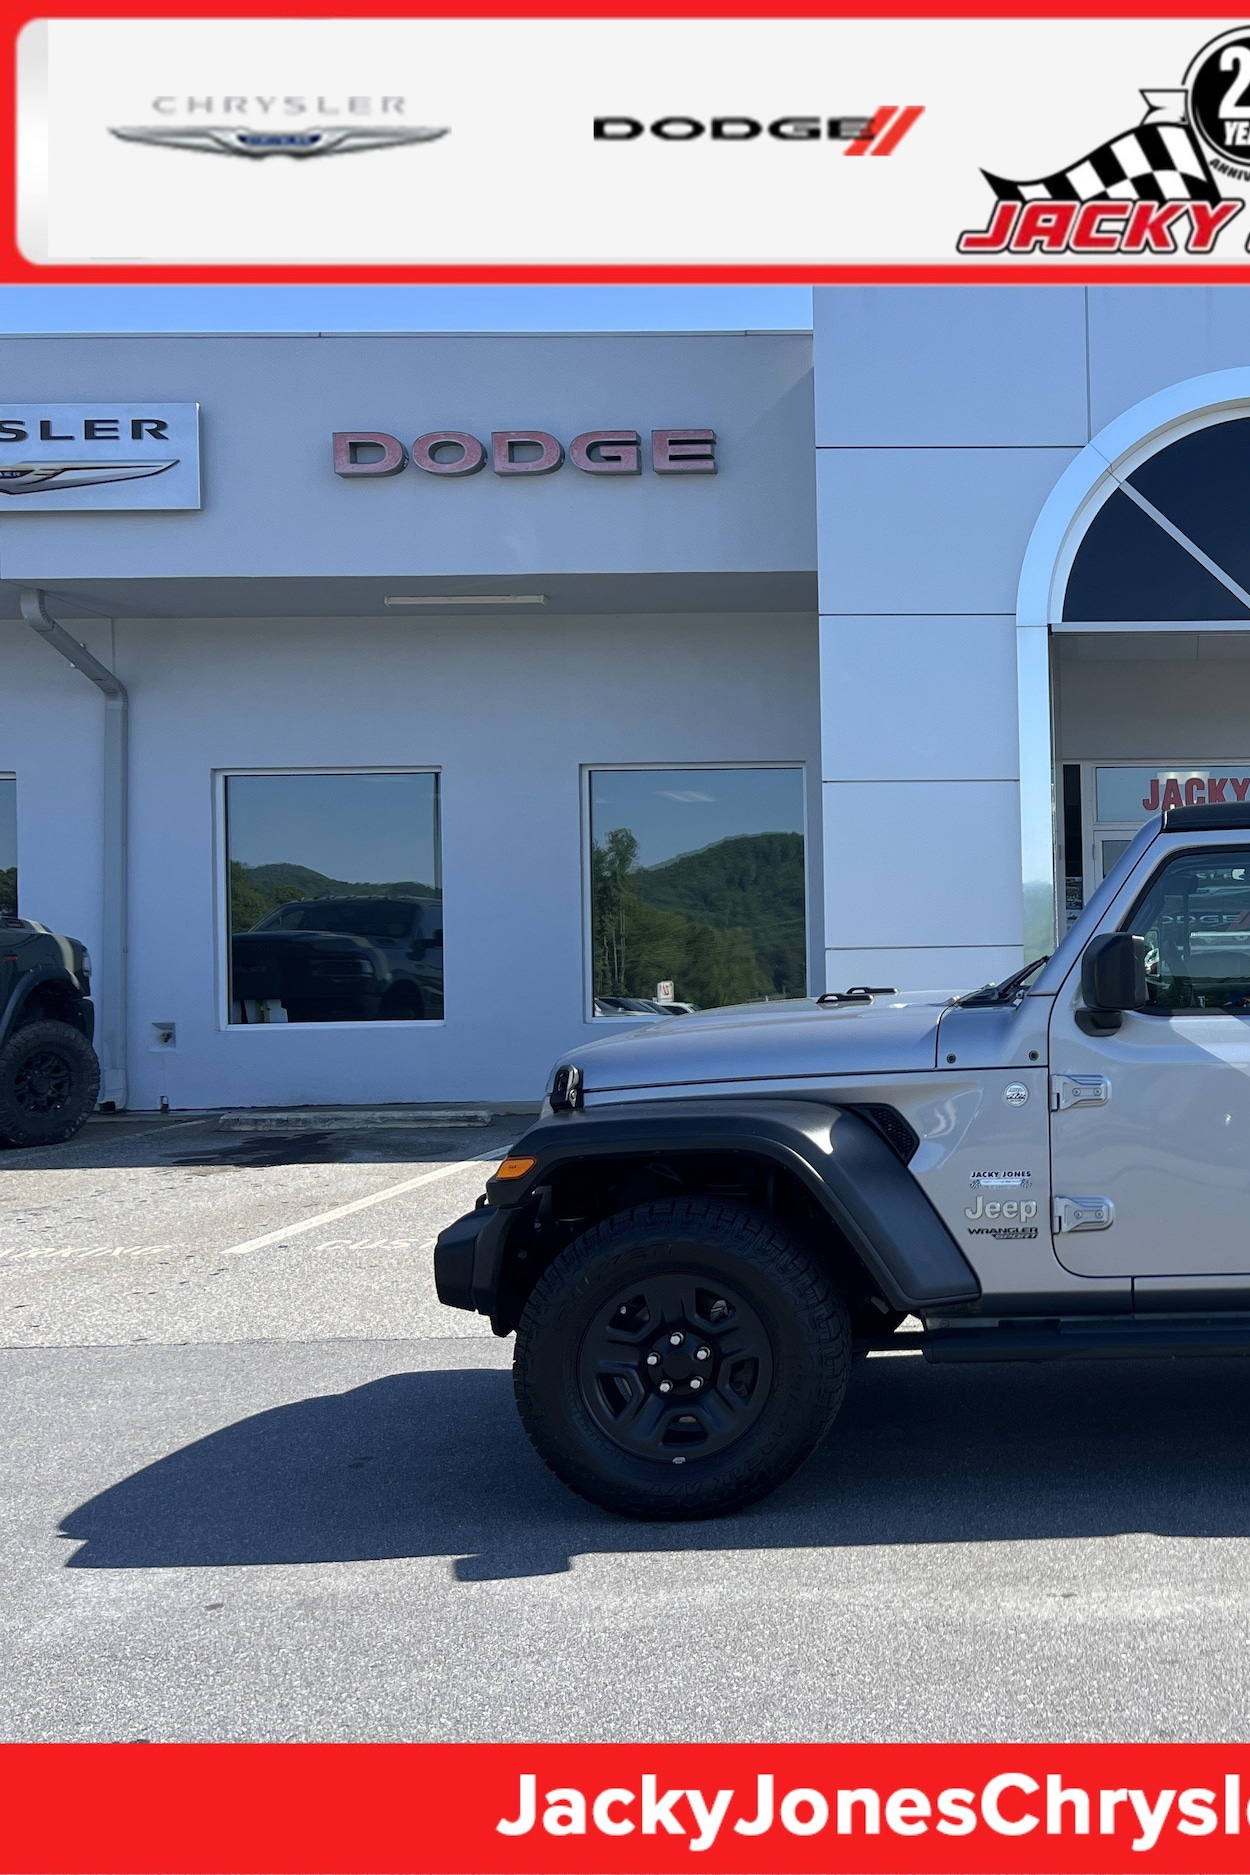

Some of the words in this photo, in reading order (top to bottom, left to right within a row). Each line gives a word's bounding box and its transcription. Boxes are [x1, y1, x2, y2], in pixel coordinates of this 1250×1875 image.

[332, 428, 718, 477] DODGE
[1002, 1170, 1032, 1178] JONES
[964, 1194, 1038, 1223] Jeep
[967, 1226, 1039, 1235] WRANGLER
